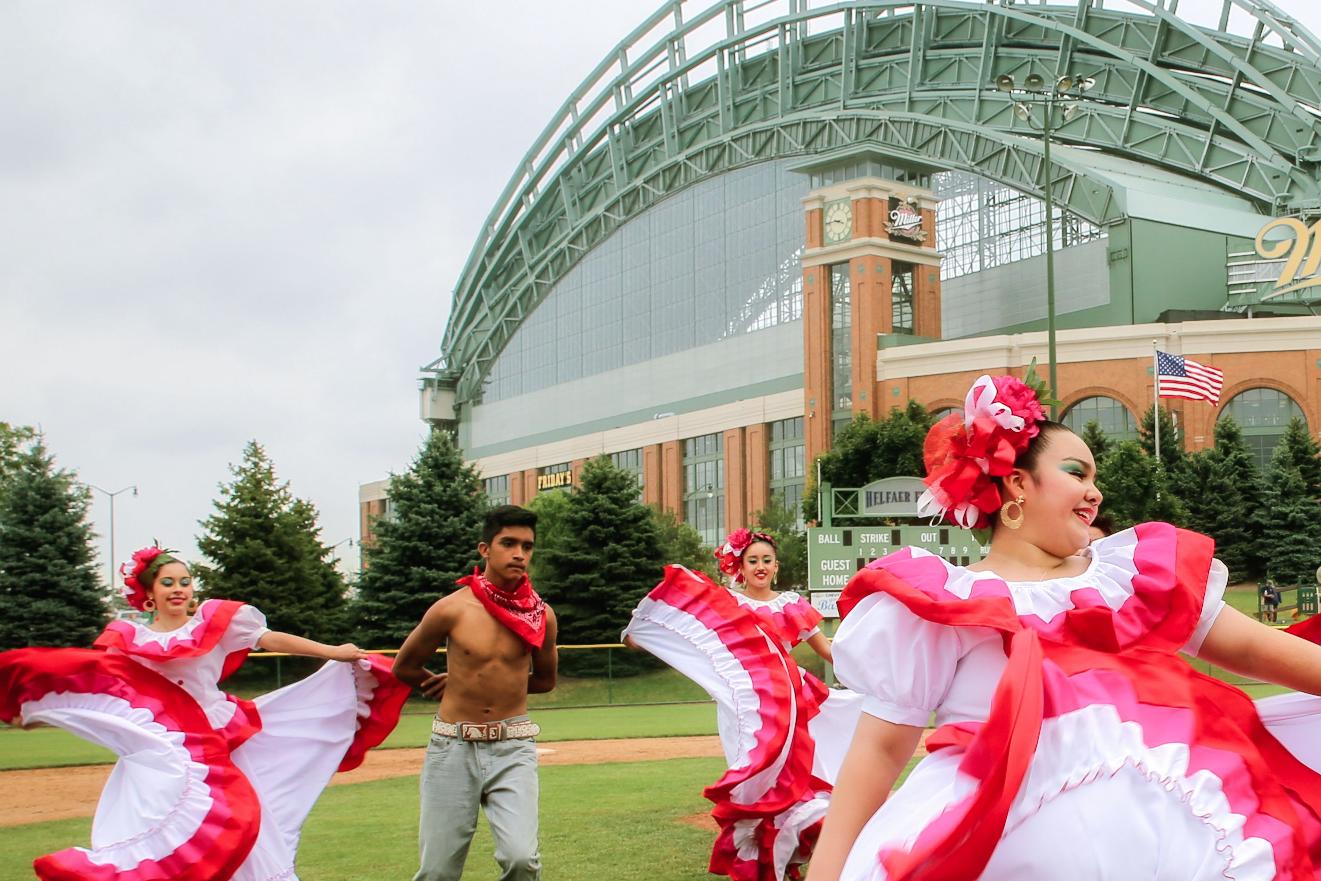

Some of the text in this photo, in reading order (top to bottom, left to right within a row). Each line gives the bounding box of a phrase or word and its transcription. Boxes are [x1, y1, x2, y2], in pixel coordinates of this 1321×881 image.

[890, 210, 922, 226] Miller
[865, 491, 911, 508] HELFAER
[818, 534, 840, 544] BALL
[860, 533, 889, 543] STRIKE
[921, 532, 937, 542] OUT
[870, 547, 876, 556] 2
[882, 547, 888, 556] 3
[938, 546, 968, 555] 7 8 9
[821, 559, 851, 571] GUEST
[822, 574, 849, 586] HOME
